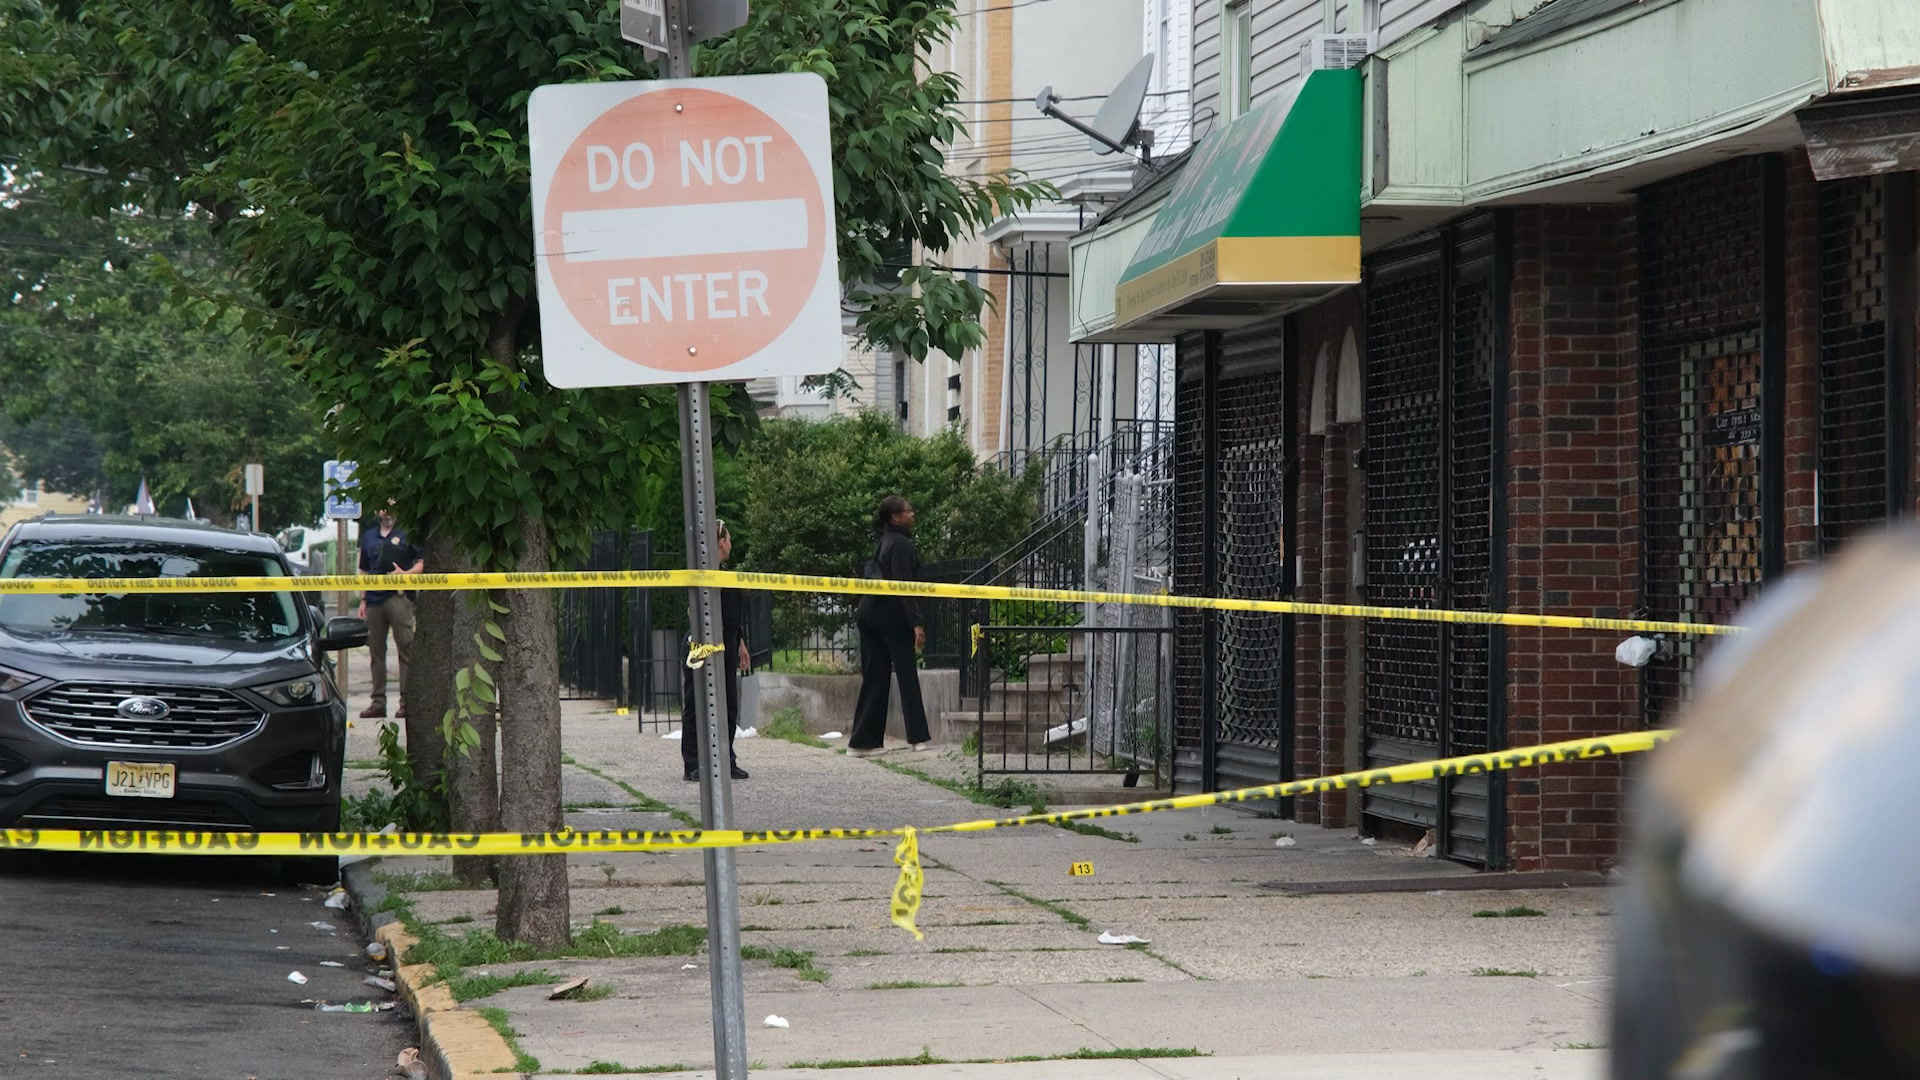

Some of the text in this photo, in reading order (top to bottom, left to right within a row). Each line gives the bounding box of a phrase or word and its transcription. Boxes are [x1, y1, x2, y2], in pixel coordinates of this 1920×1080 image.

[586, 136, 772, 192] DO NOT
[608, 270, 770, 325] ENTER
[130, 701, 158, 715] Ford
[112, 770, 170, 789] J21 VPG
[1077, 863, 1090, 874] 13
